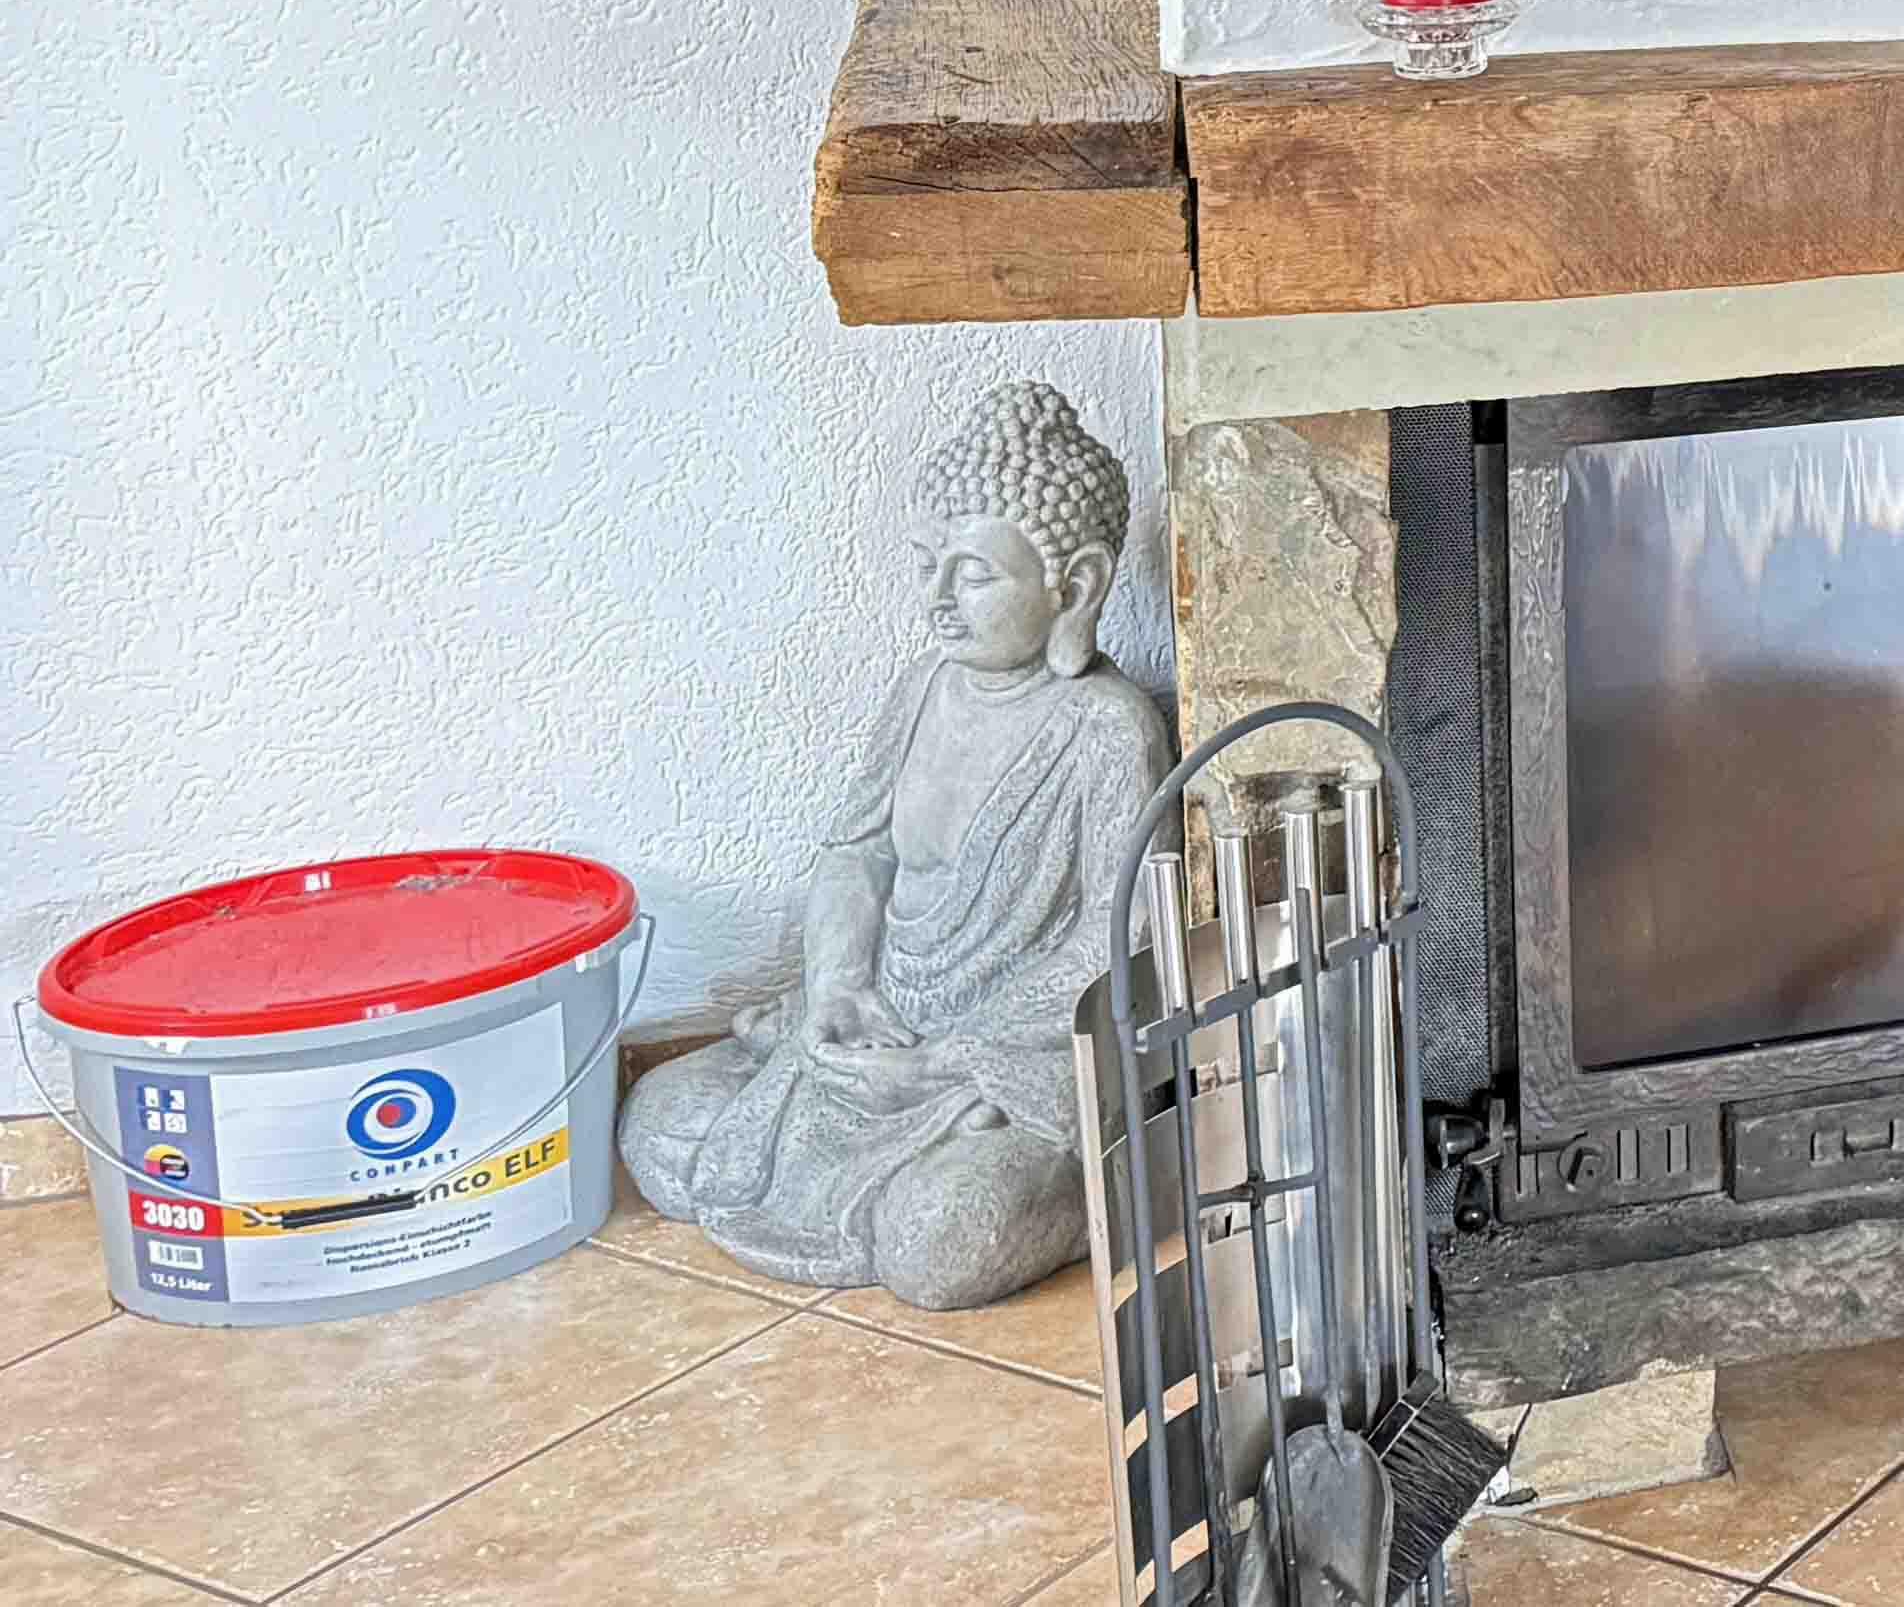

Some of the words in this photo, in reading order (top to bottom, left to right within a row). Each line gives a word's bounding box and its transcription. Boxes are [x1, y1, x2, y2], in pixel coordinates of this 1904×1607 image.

[350, 1148, 459, 1182] COMPART
[504, 1138, 555, 1178] ELF
[142, 1200, 205, 1231] 3030
[179, 1277, 213, 1291] Liter
